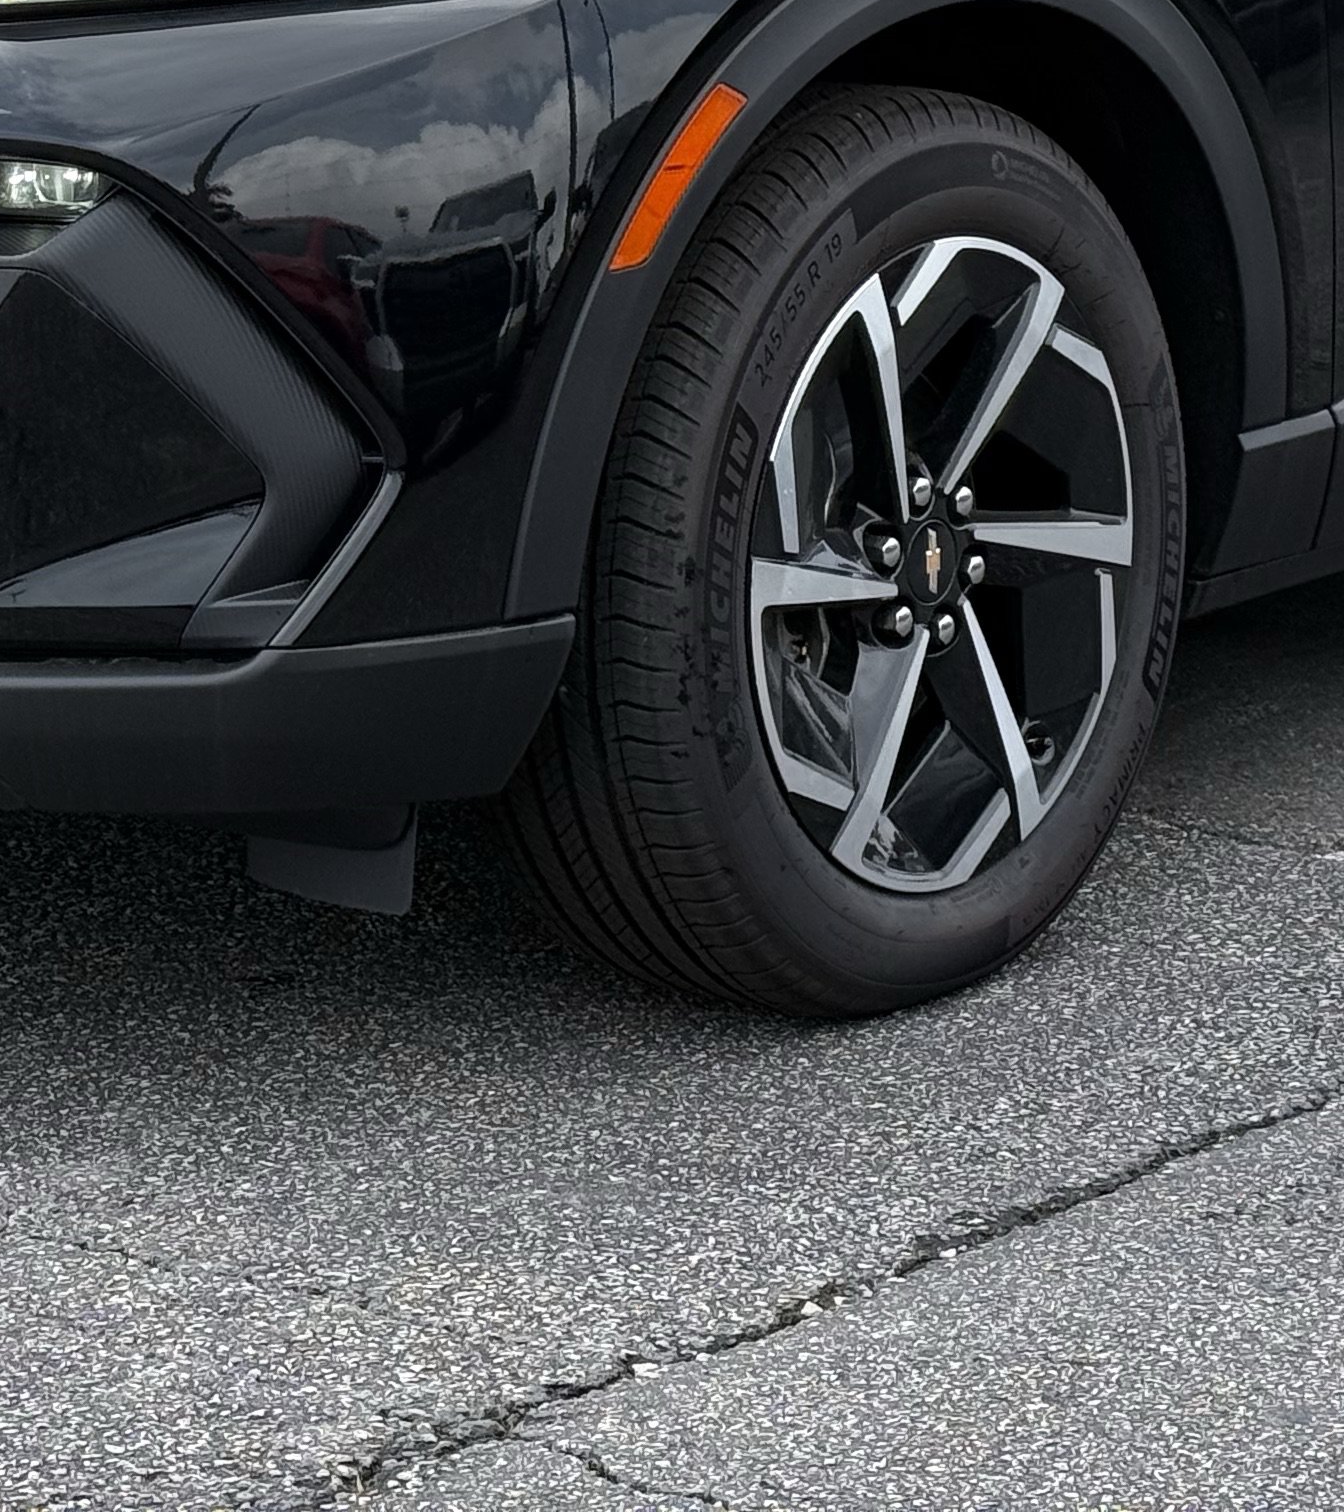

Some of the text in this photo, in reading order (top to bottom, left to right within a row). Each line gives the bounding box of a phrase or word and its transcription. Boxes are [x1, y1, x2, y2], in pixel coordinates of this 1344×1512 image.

[754, 232, 842, 388] 245/55 R 19
[709, 429, 755, 695] MICHELIN
[1146, 444, 1181, 692] MICHELIN
